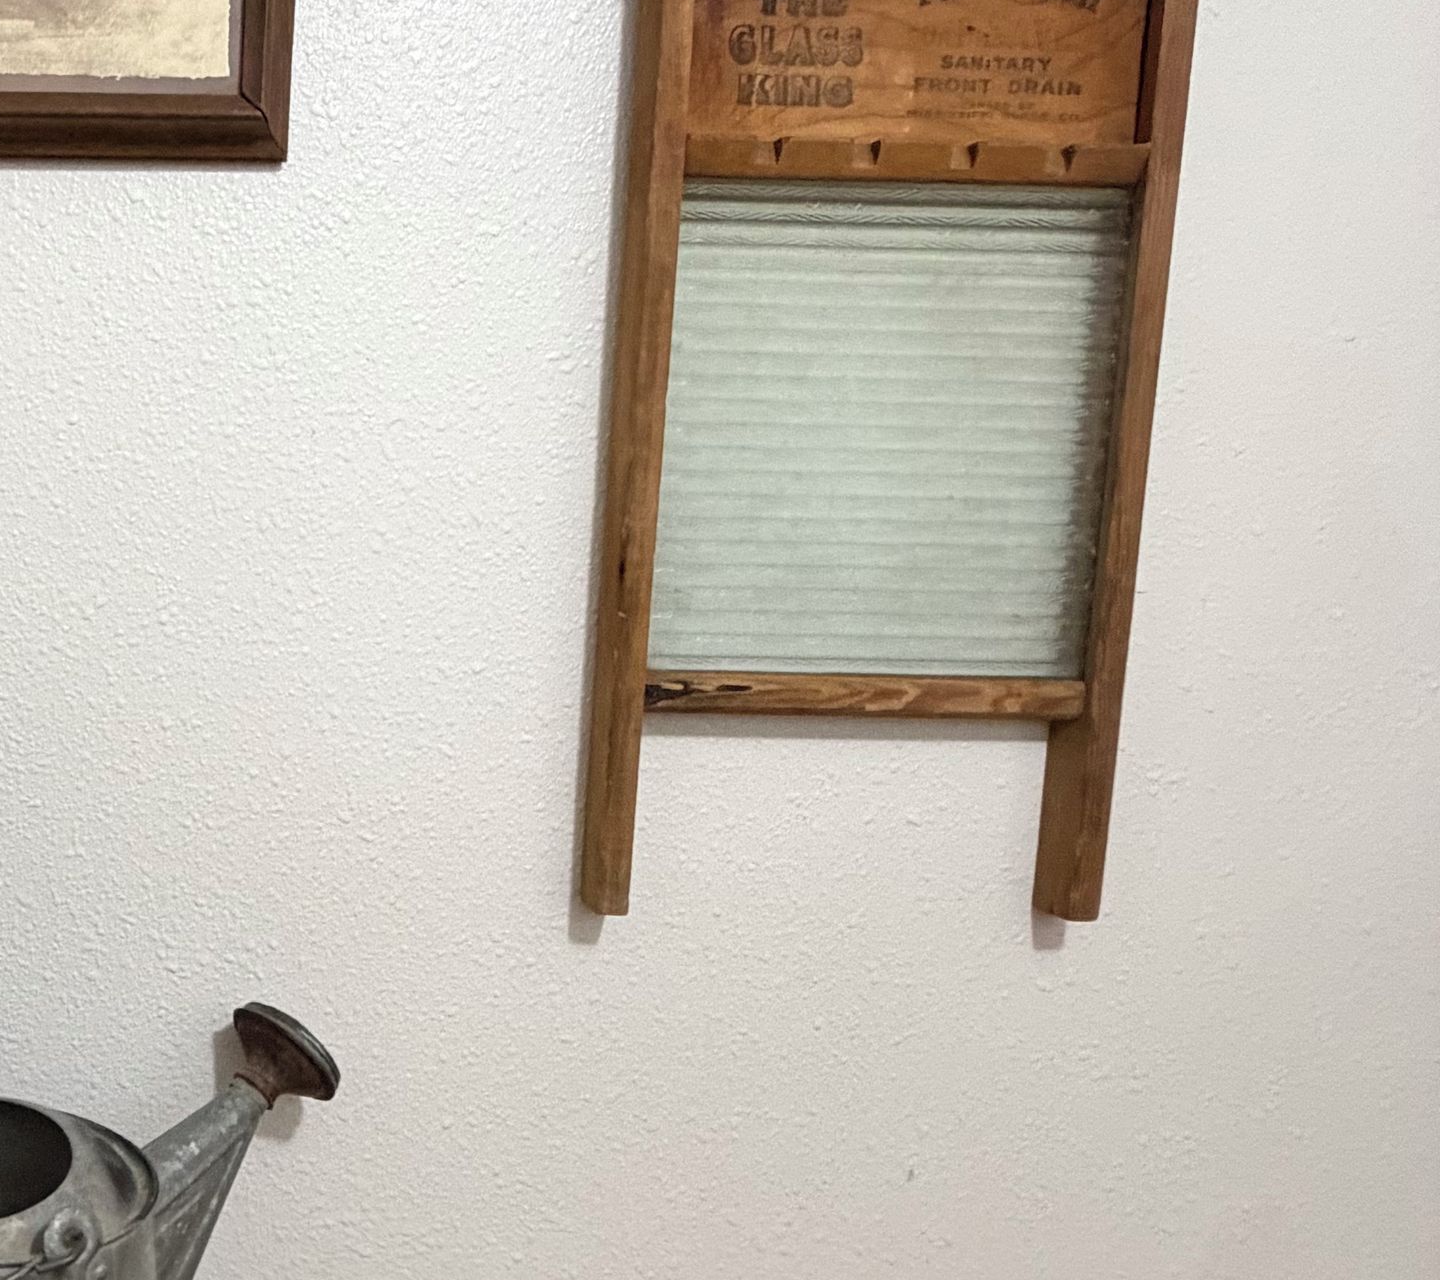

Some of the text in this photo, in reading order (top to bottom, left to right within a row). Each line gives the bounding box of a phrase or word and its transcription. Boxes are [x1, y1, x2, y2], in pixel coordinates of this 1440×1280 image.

[728, 23, 864, 67] GLASS
[939, 54, 1052, 72] SANITARY
[736, 73, 854, 108] KING
[913, 77, 1082, 95] FRONT DRAIN
